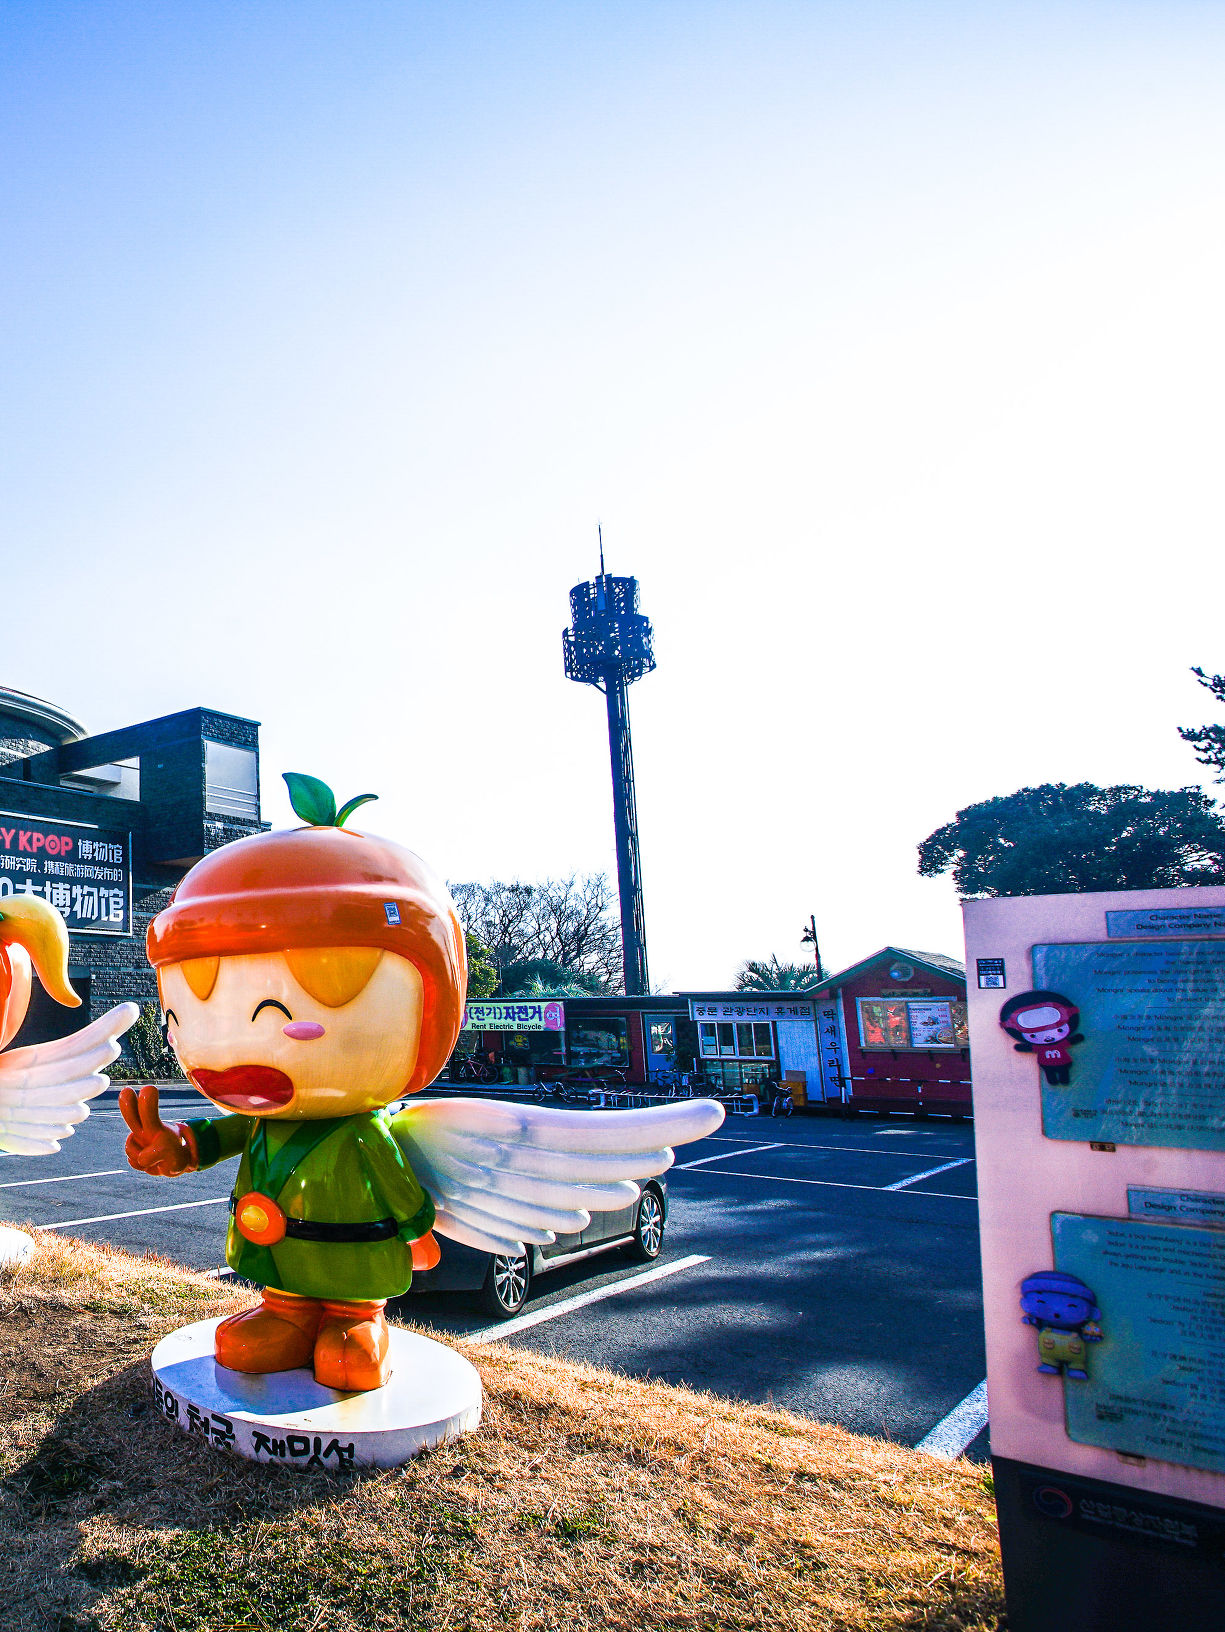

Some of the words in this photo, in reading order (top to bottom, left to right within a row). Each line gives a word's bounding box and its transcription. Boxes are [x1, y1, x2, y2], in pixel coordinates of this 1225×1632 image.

[19, 831, 73, 857] KPOP
[78, 838, 123, 865] 博物馆
[1136, 922, 1166, 931] Design
[1167, 921, 1211, 930] Company
[696, 1006, 718, 1016] 중문
[471, 1022, 487, 1030] Rent
[489, 1022, 514, 1030] Electric
[516, 1022, 542, 1031] Bicycle
